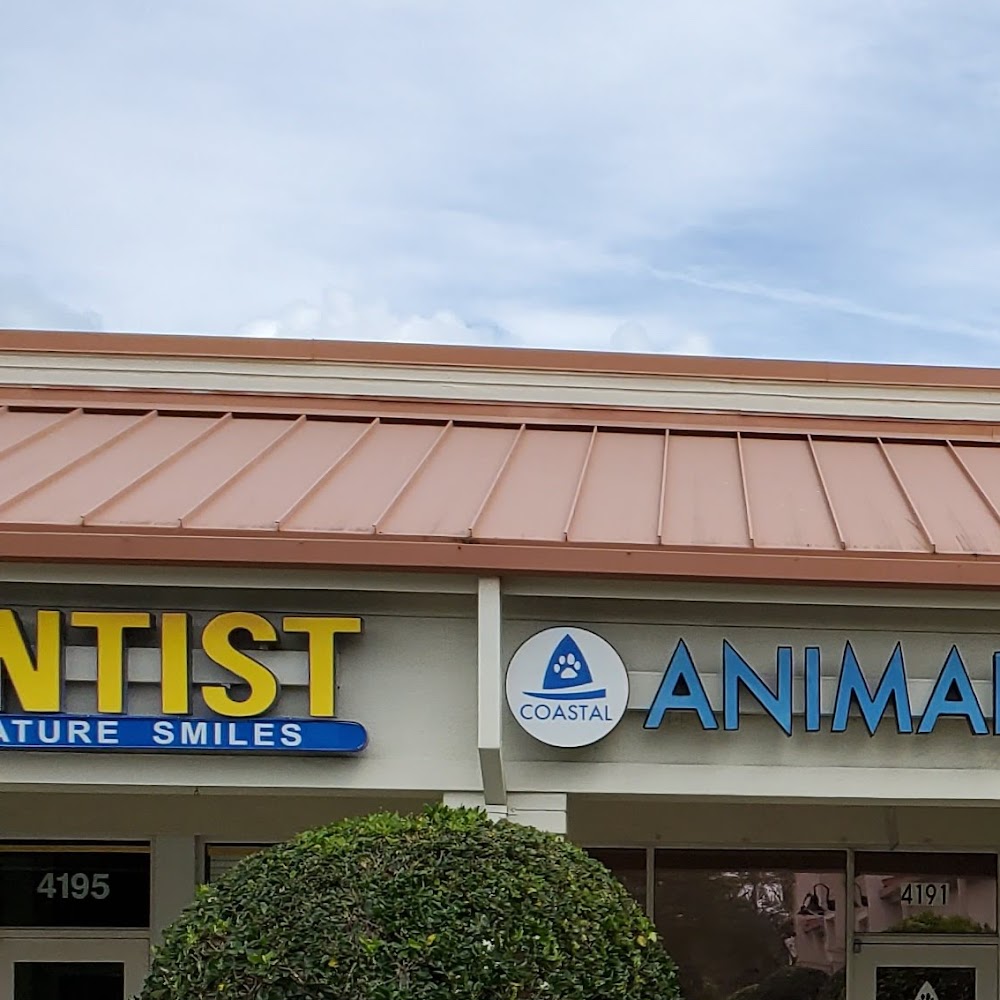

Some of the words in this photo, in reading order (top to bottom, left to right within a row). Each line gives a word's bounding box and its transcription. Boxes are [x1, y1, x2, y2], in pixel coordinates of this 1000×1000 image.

[520, 704, 613, 721] COASTAL
[153, 721, 302, 746] SMILES
[37, 872, 110, 900] 4195
[901, 883, 946, 905] 4191
